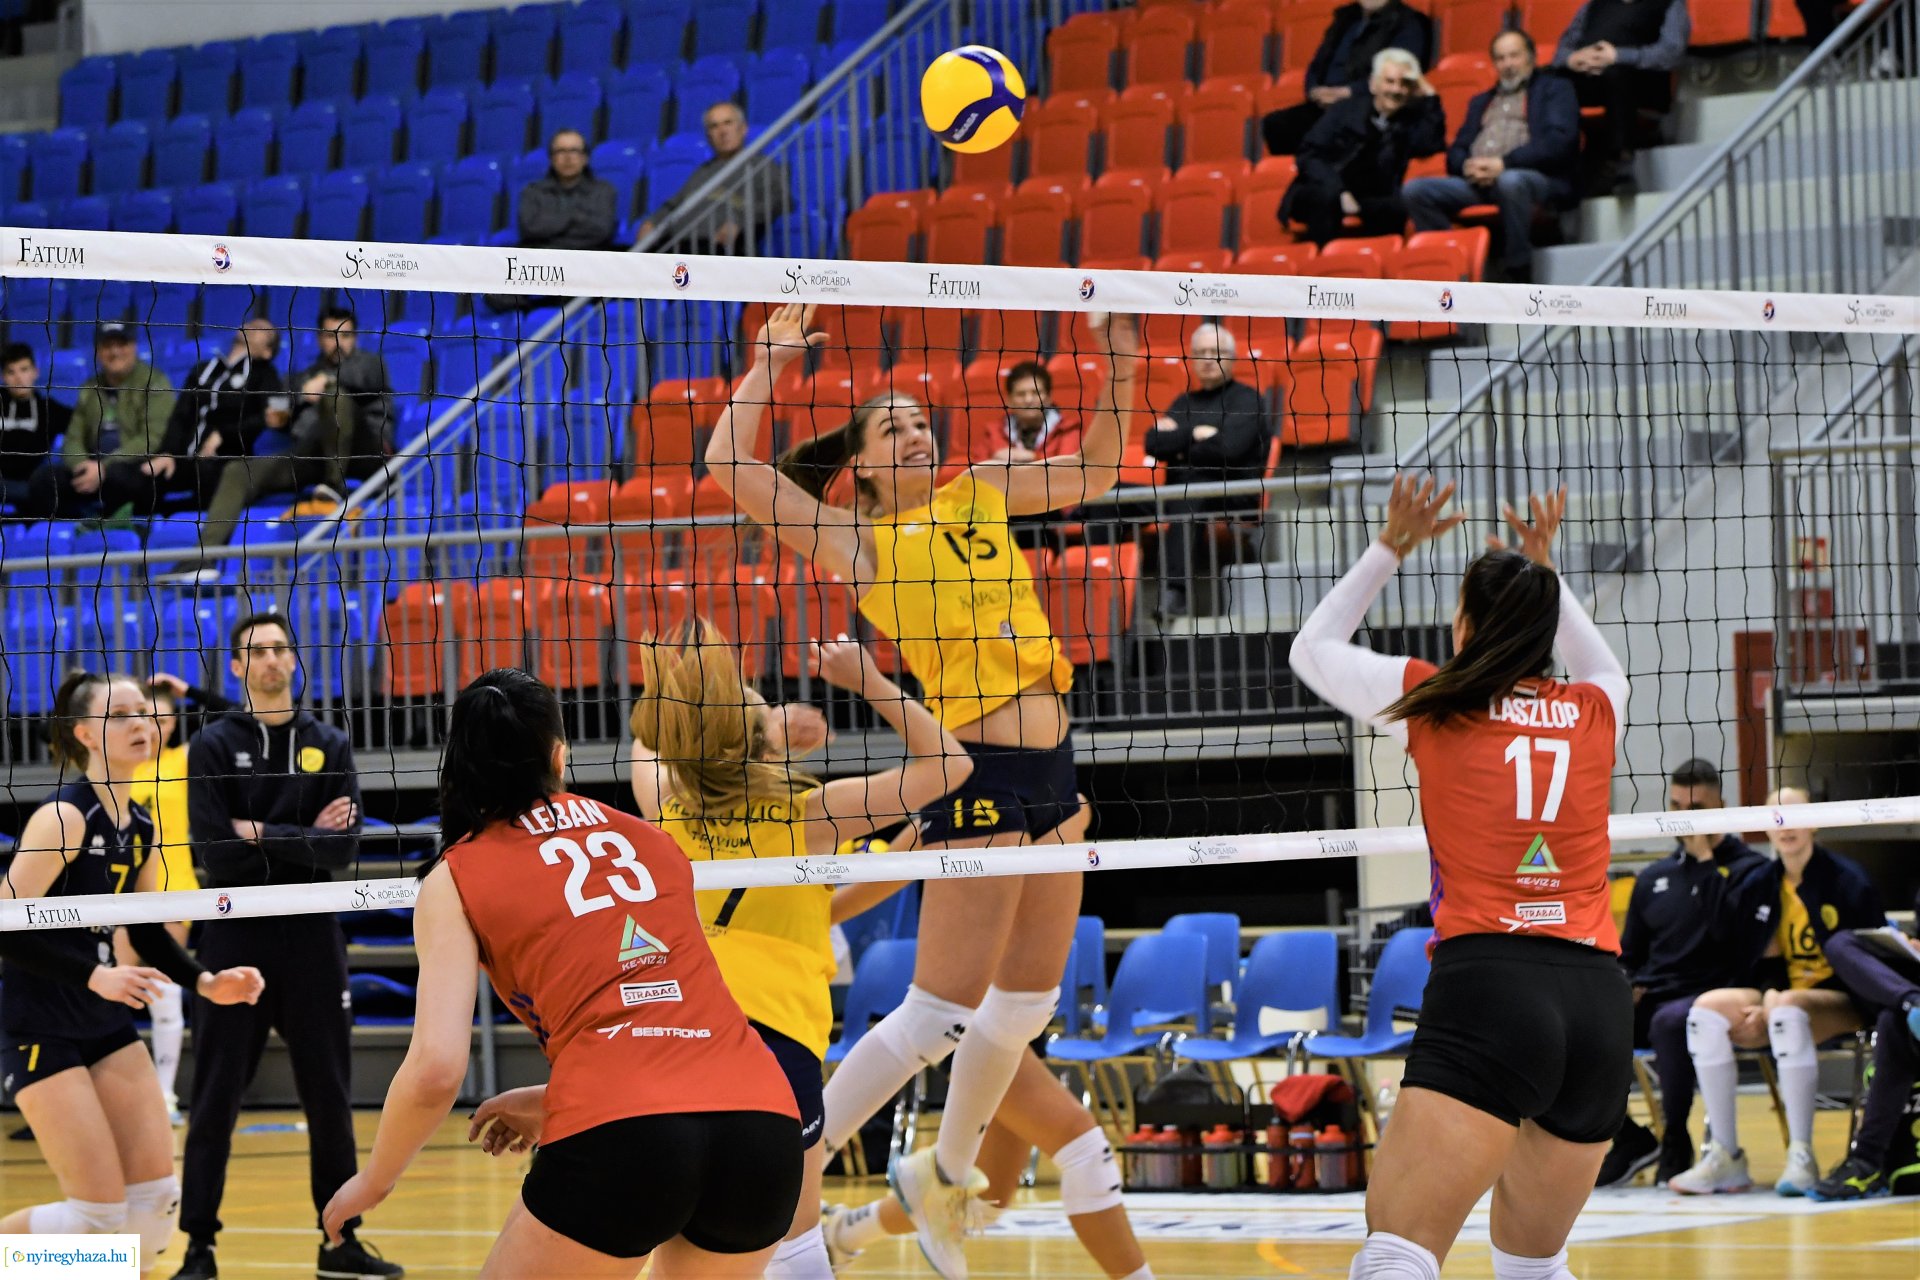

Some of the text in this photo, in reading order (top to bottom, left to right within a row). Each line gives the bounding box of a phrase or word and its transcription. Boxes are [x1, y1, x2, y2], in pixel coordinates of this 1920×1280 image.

[18, 235, 85, 264] FATUM
[374, 257, 419, 270] RÖPLABDA
[505, 255, 565, 282] FATUM
[810, 274, 851, 286] RÖPLABDA
[928, 271, 980, 296] FATUM
[1307, 284, 1355, 307] FATUM
[1643, 295, 1687, 317] FATUM
[943, 526, 998, 565] 15
[1489, 697, 1580, 728] LASZLOP
[1504, 735, 1571, 822] 17
[519, 799, 609, 836] LEBAN
[953, 798, 1000, 828] 15
[1318, 837, 1359, 853] FATUM
[538, 831, 657, 918] 23
[939, 854, 984, 873] FATUM
[110, 863, 130, 894] 7
[24, 903, 82, 924] FATUM
[1789, 923, 1816, 951] 16
[624, 986, 678, 1001] STRABAG
[631, 1027, 711, 1039] BESTRONG
[18, 1044, 40, 1072] 7
